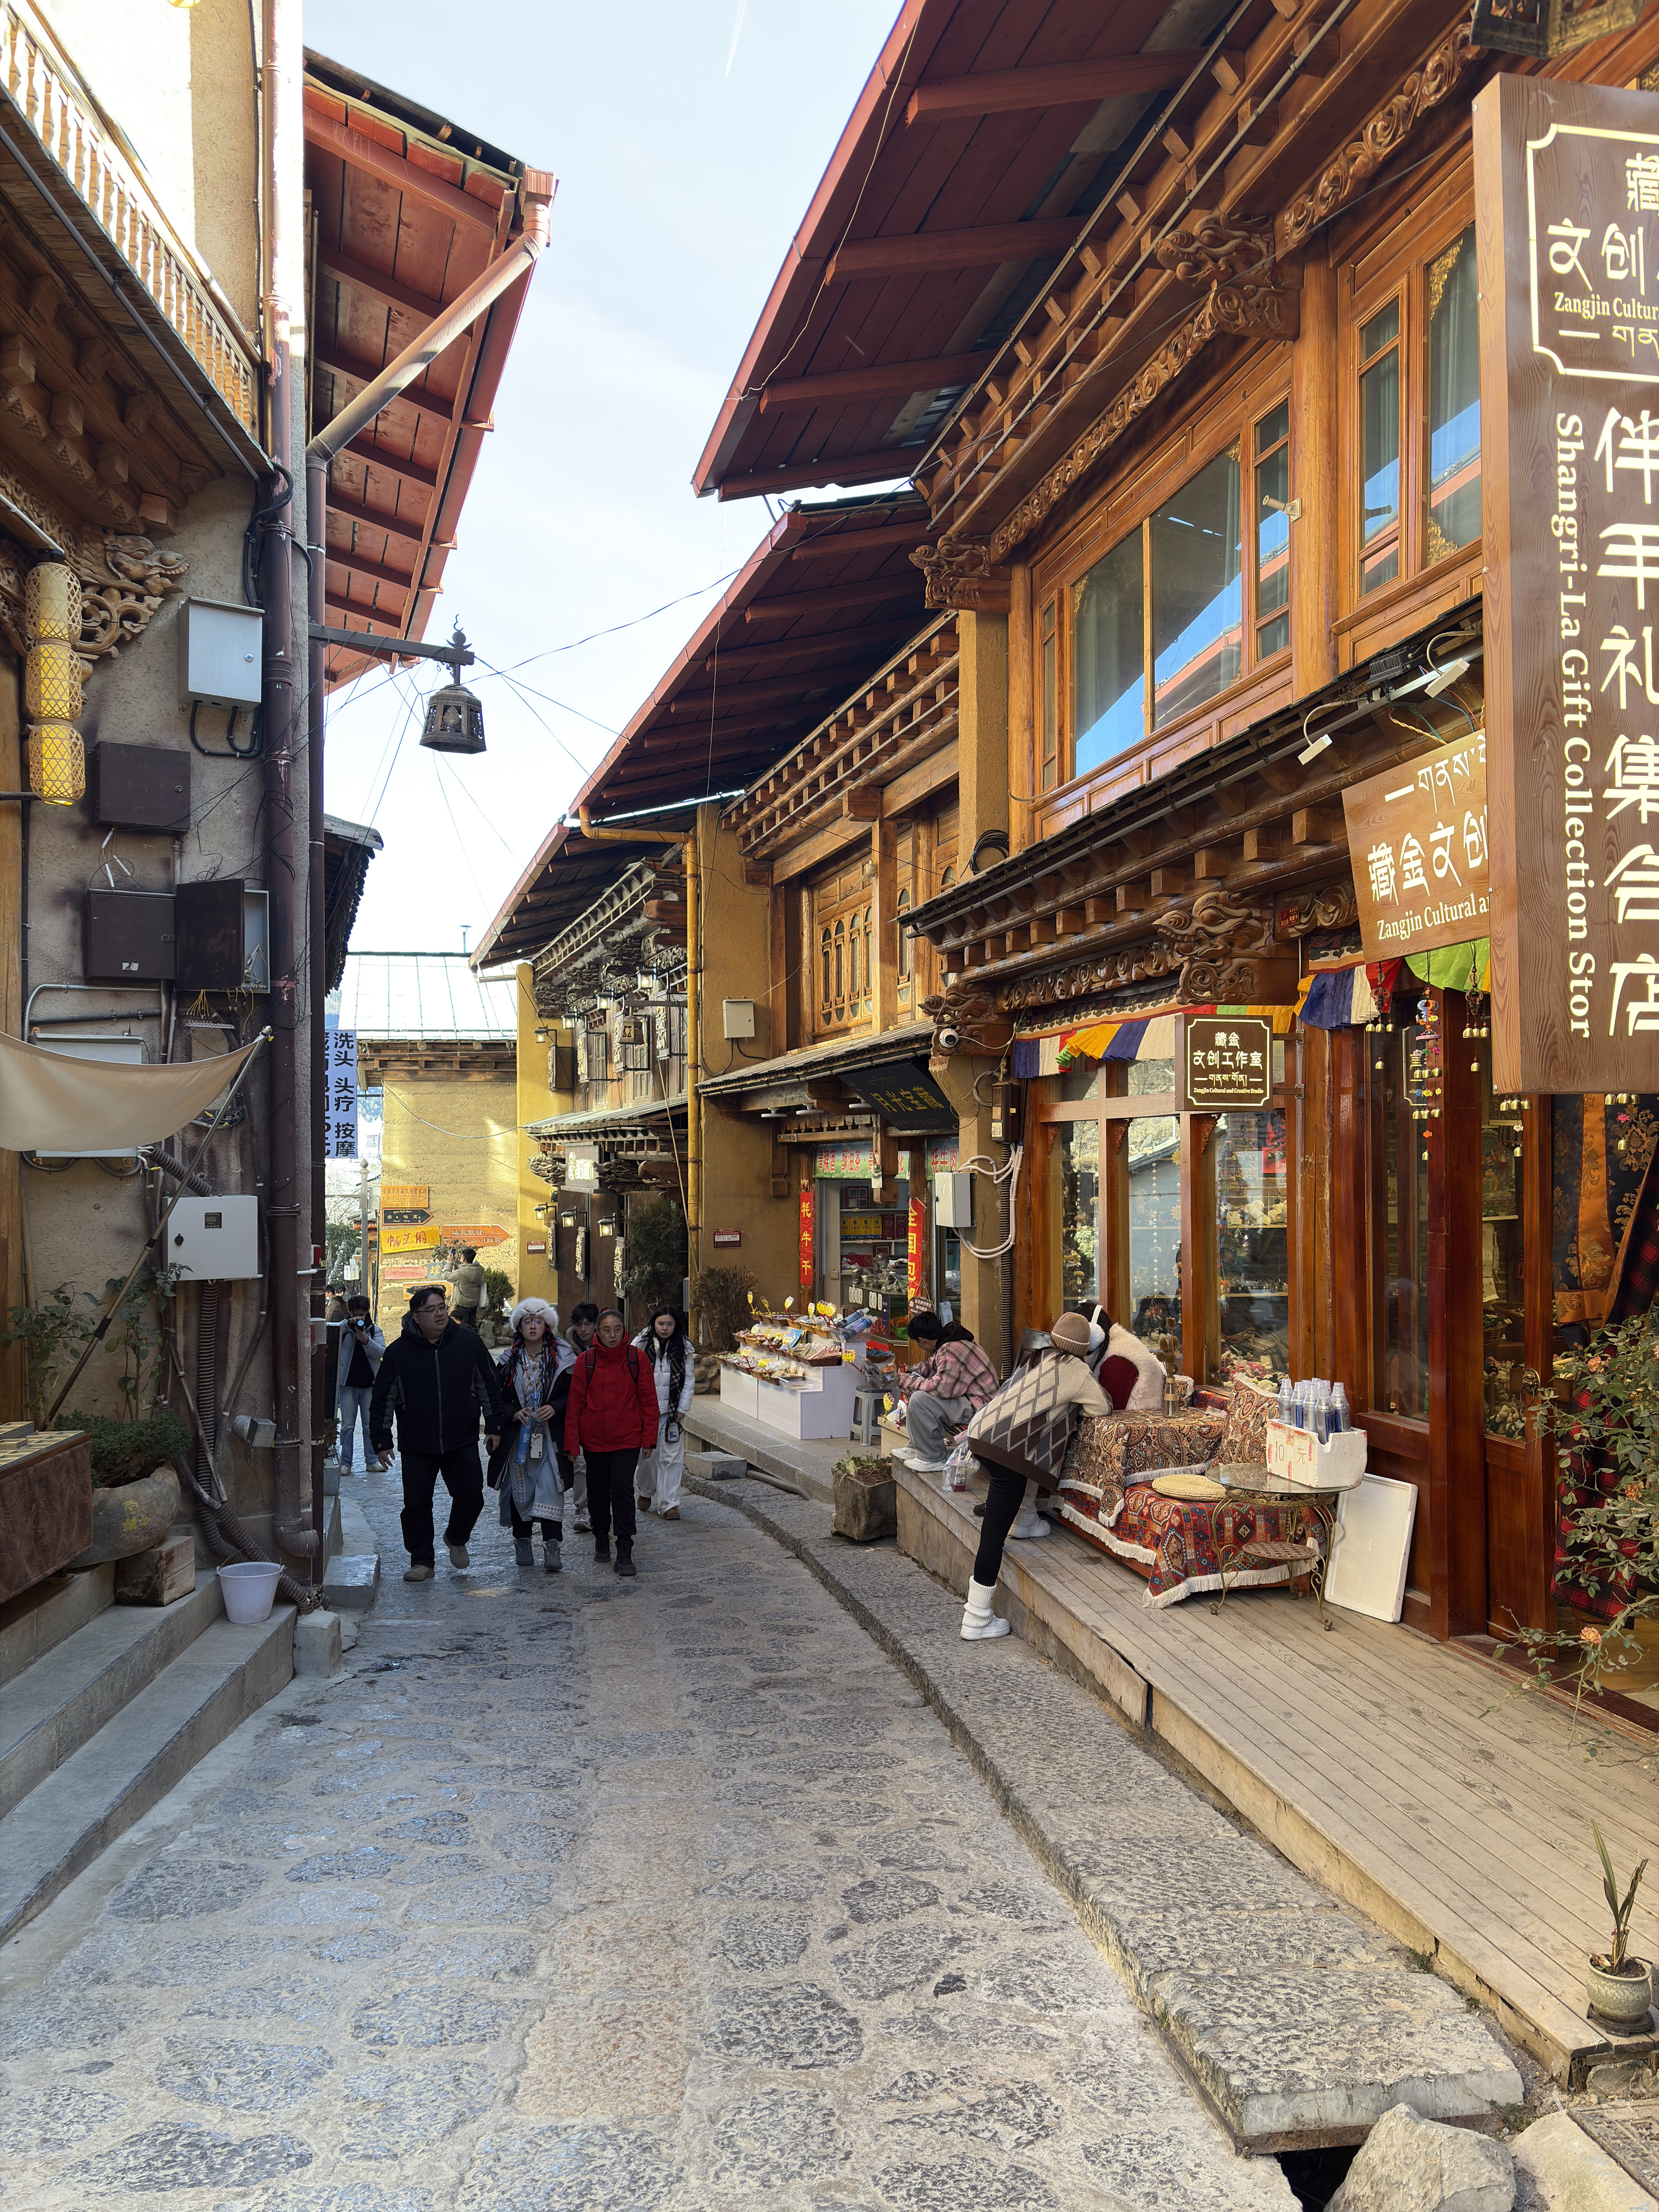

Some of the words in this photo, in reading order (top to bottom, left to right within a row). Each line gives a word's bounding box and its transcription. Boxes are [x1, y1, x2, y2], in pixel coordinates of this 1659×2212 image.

[1547, 217, 1659, 296] 文创
[1554, 292, 1610, 320] Zangjin
[1552, 413, 1588, 640] Shangri-La
[1561, 649, 1592, 728] Gift
[1368, 805, 1489, 906] 藏金文创
[1563, 737, 1595, 941] Collection
[1377, 910, 1422, 941] Zangjin
[1424, 893, 1476, 928] Cultural
[1569, 951, 1595, 1038] Stor
[333, 1032, 354, 1067] 洗头
[1193, 1050, 1262, 1071] 文创工作室
[1215, 1032, 1240, 1049] 藏金
[334, 1077, 354, 1112] 头疗
[870, 1086, 945, 1113] 月光宝藏
[335, 1122, 356, 1157] 按摩
[931, 1145, 958, 1175] 牦牛肉
[801, 1201, 811, 1275] 牦牛干
